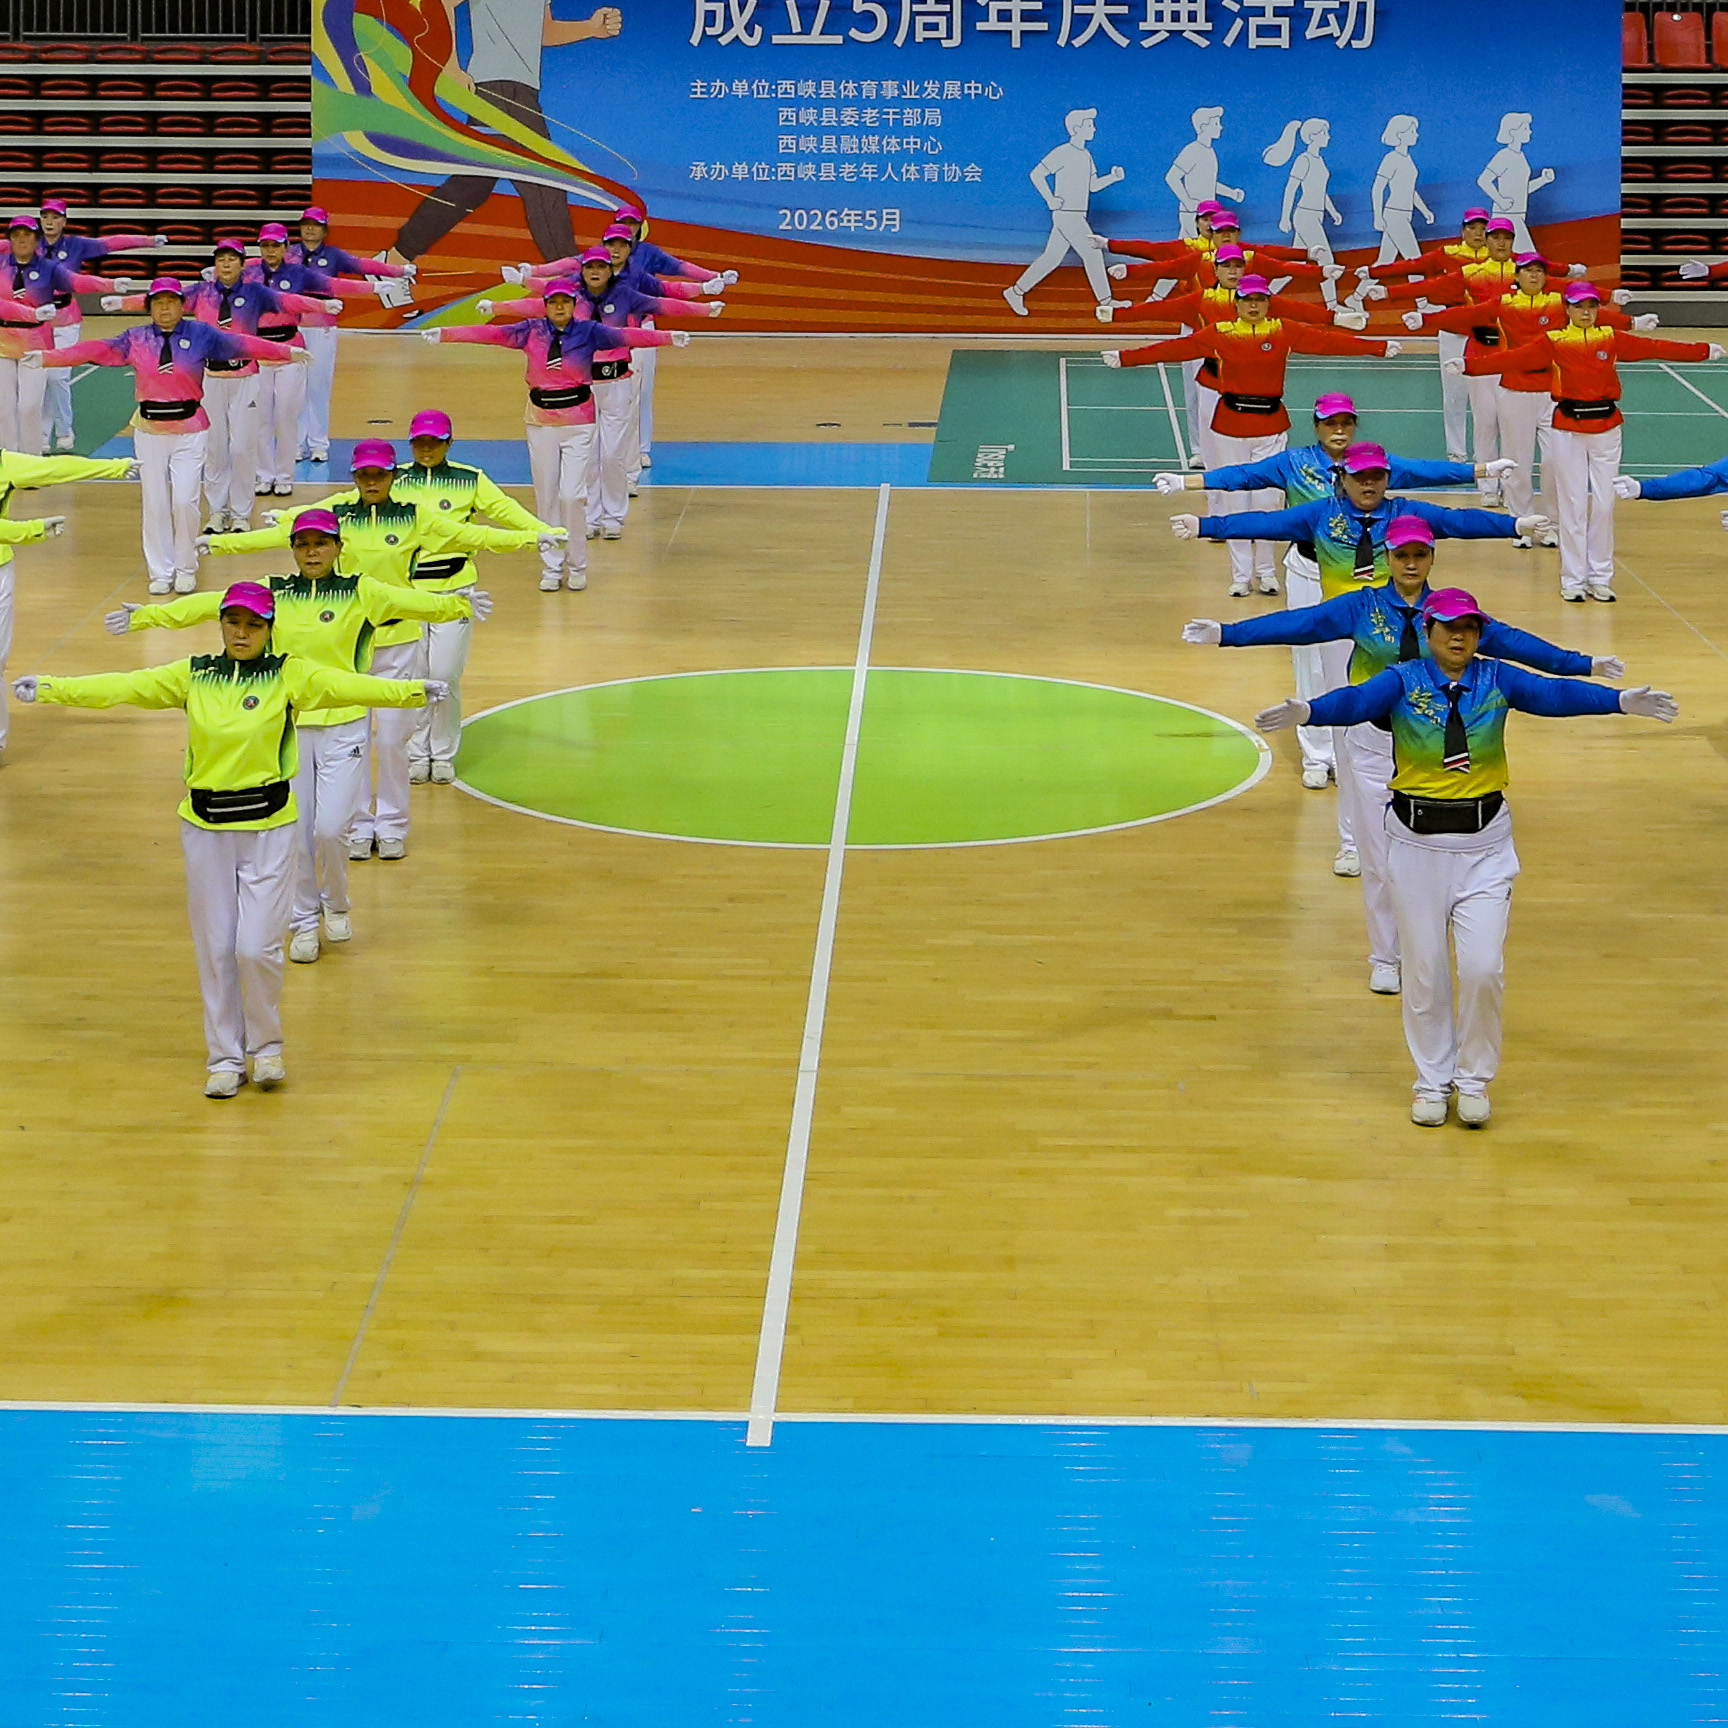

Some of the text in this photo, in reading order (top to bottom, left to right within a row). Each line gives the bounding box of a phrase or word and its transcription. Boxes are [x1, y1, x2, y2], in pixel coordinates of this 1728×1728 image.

[688, 79, 1004, 100] 主办单位:西峡县体育事业发展中心
[778, 107, 942, 128] 西峡县委老干部局
[778, 134, 943, 155] 西峡县融媒体中心
[688, 161, 983, 183] 承办单位:西峡县老年人体育协会
[778, 207, 902, 233] 2026年5月
